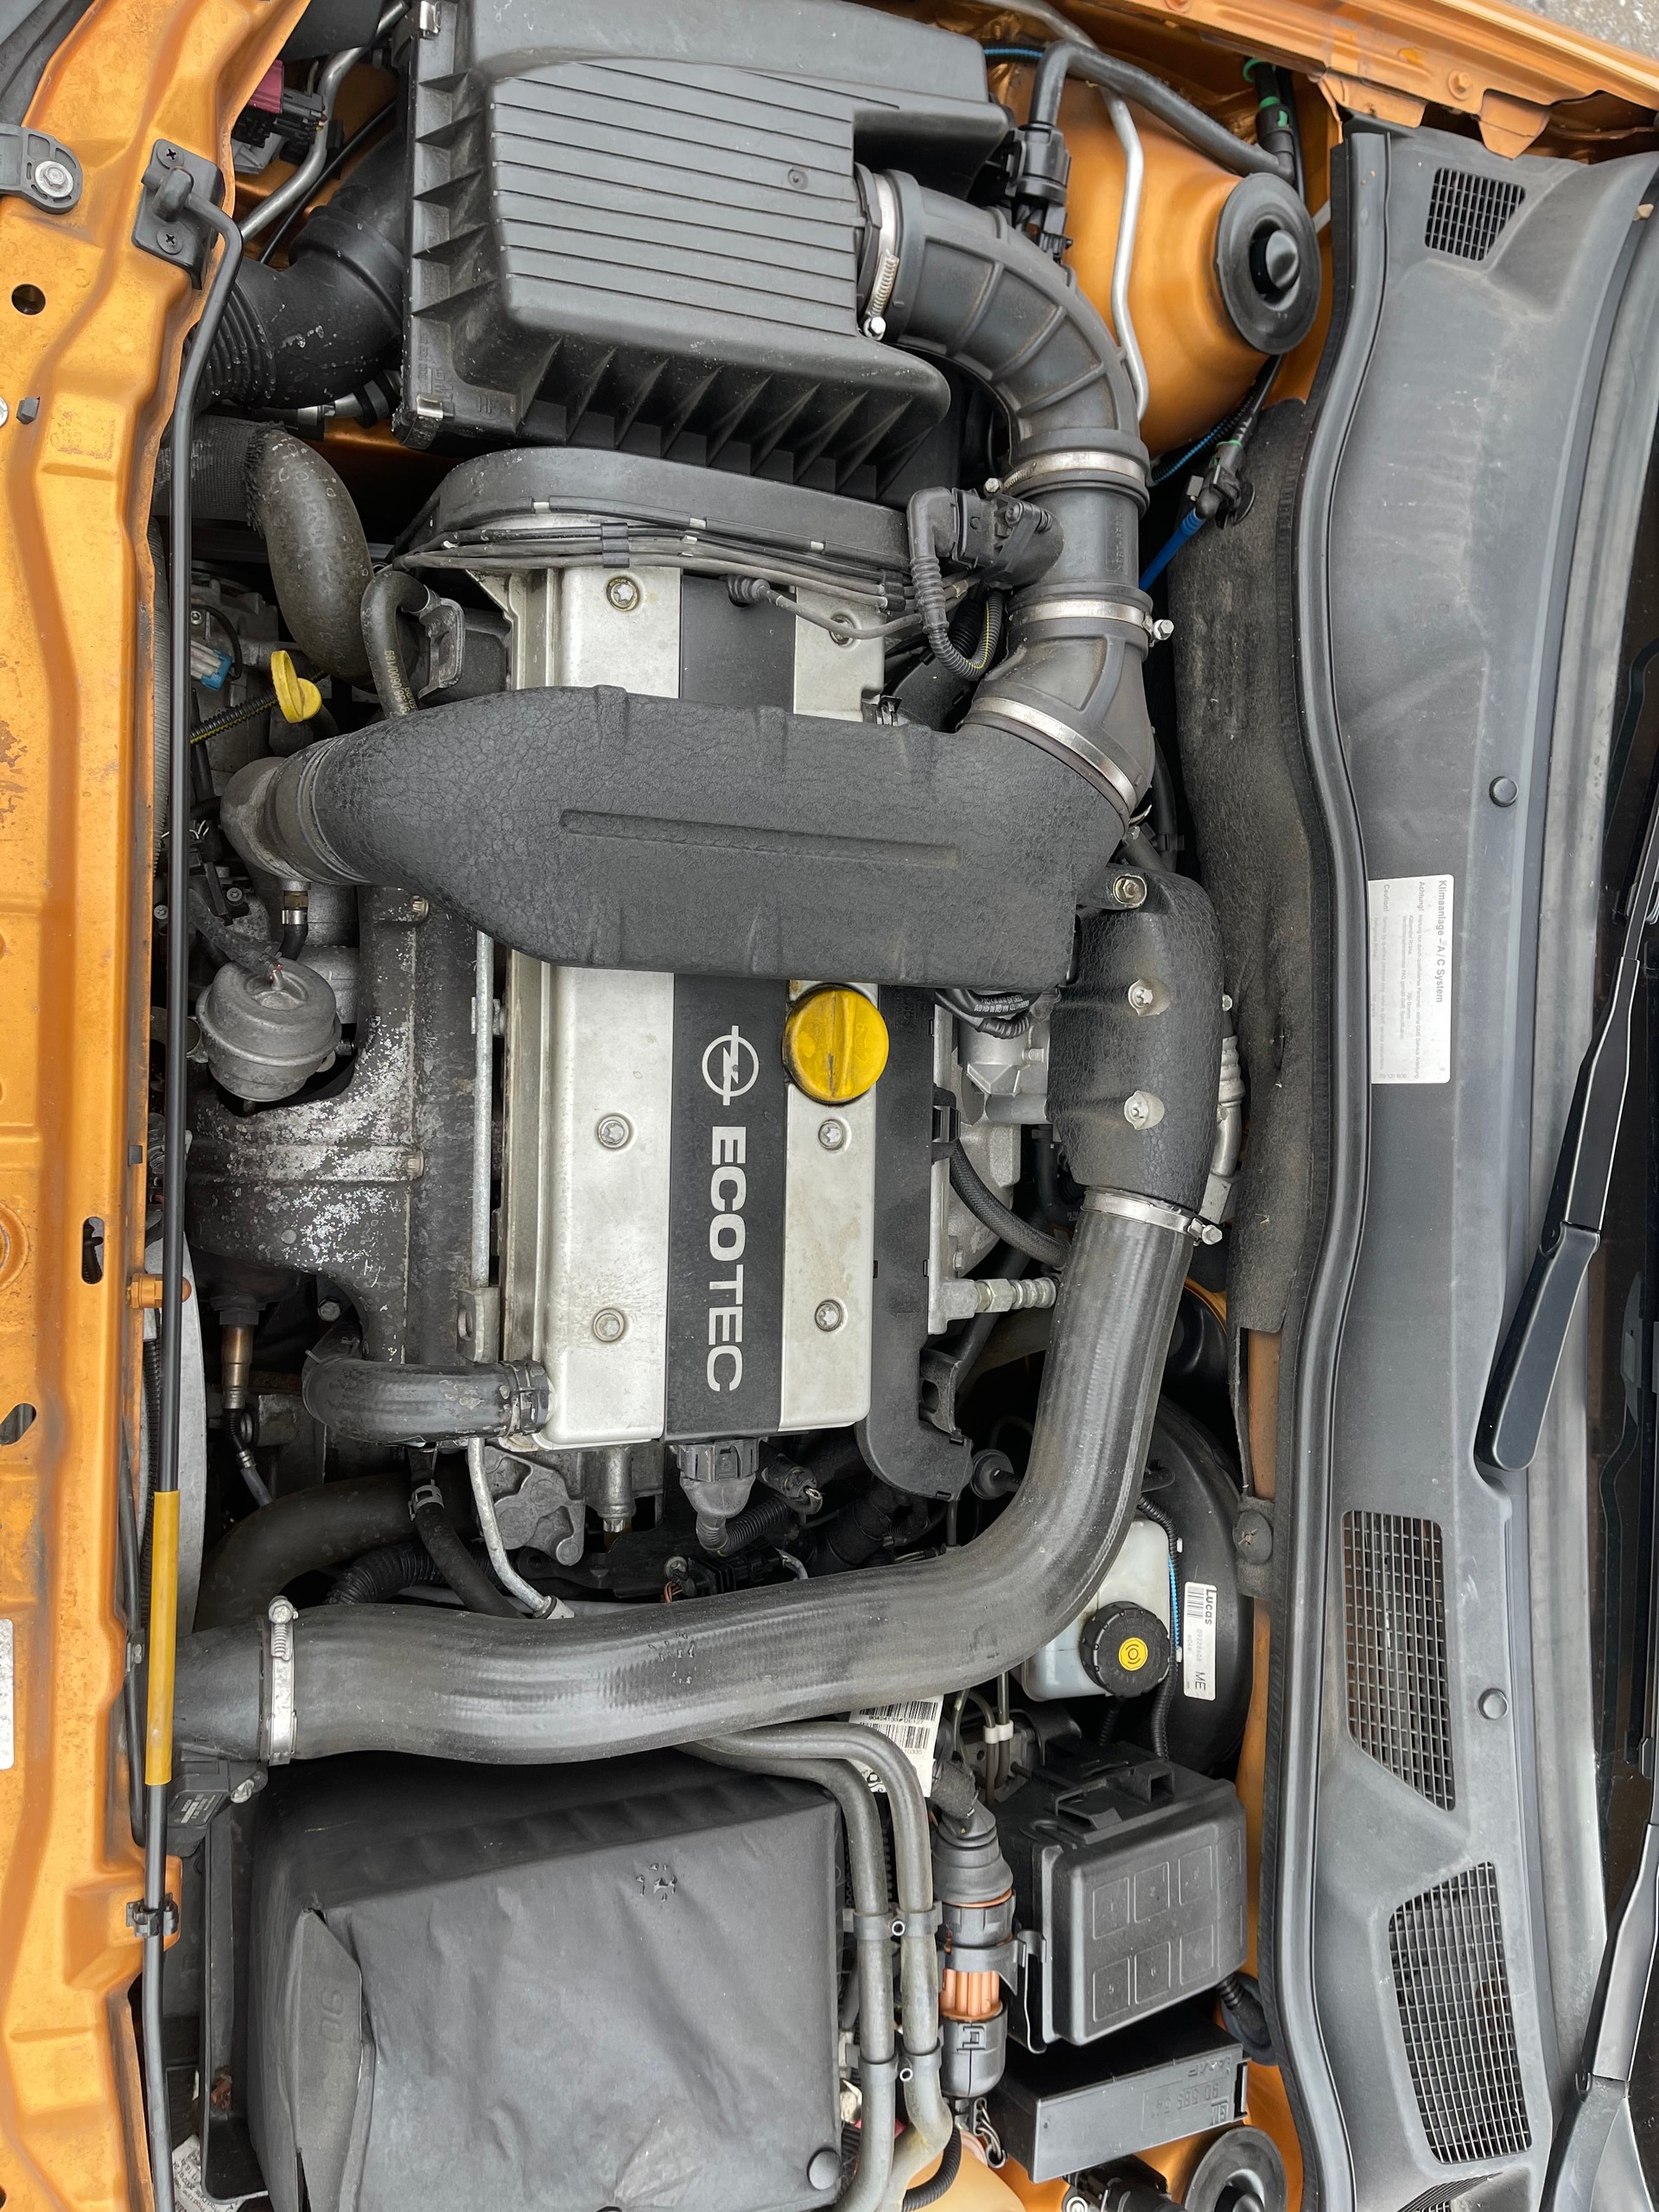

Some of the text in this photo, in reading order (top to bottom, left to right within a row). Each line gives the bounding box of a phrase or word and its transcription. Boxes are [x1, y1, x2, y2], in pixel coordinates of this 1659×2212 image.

[1417, 881, 1426, 912] Achtung!
[1436, 880, 1446, 936] Klimaanlage
[1434, 969, 1445, 1002] System
[705, 1127, 747, 1393] ECOTEC
[1205, 1588, 1217, 1625] Lucas
[1195, 1671, 1206, 1691] ME
